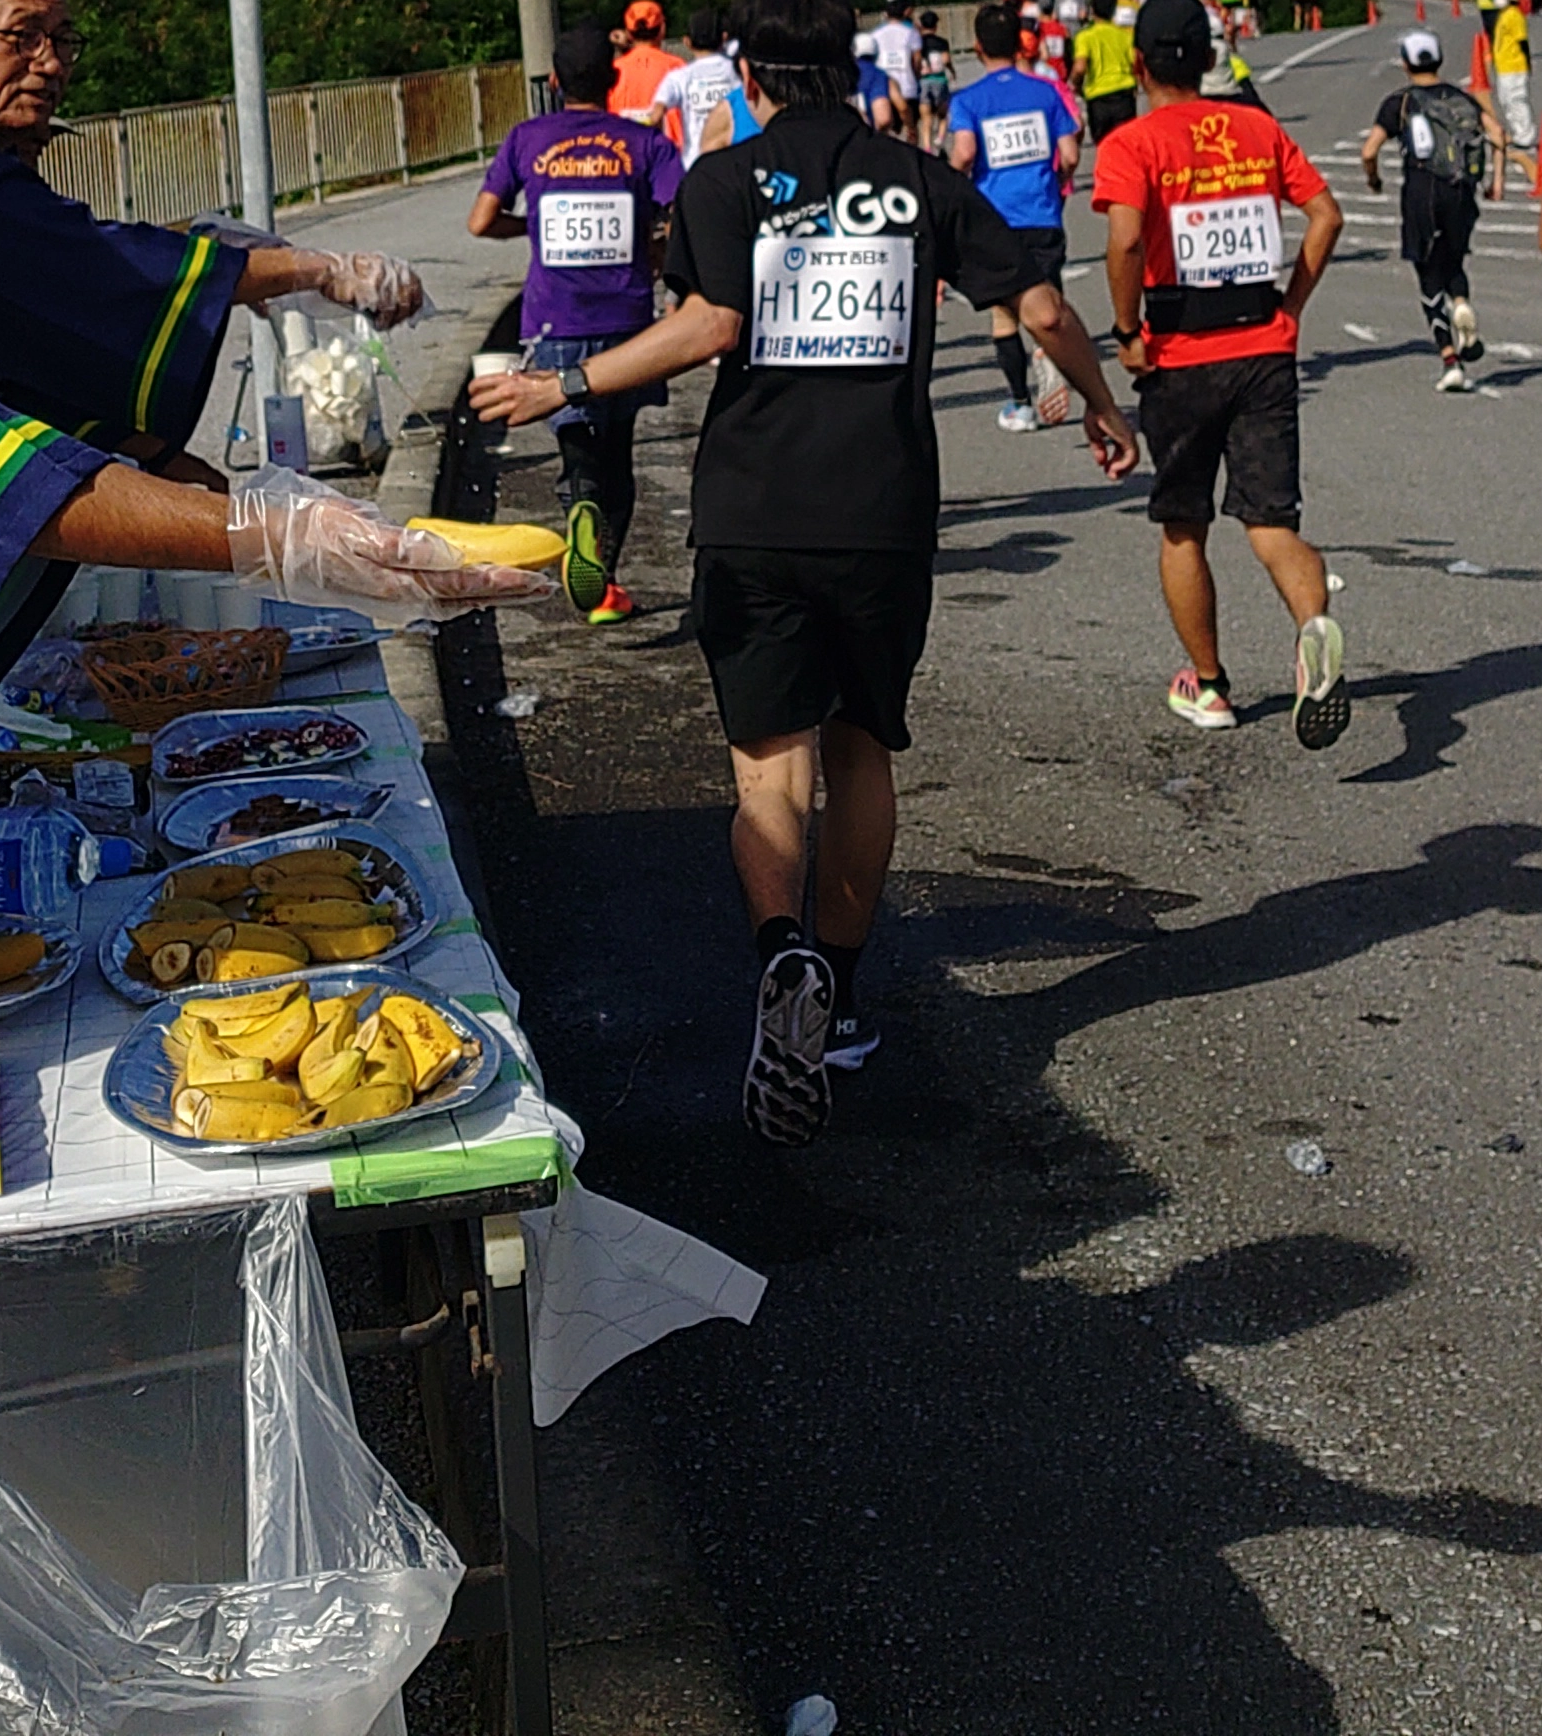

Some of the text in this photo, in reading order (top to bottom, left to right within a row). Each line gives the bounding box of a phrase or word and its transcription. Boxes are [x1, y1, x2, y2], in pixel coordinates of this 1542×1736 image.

[1003, 128, 1039, 149] 3161
[836, 180, 919, 235] Go
[545, 216, 621, 242] E 5513
[1178, 224, 1267, 260] D 2941
